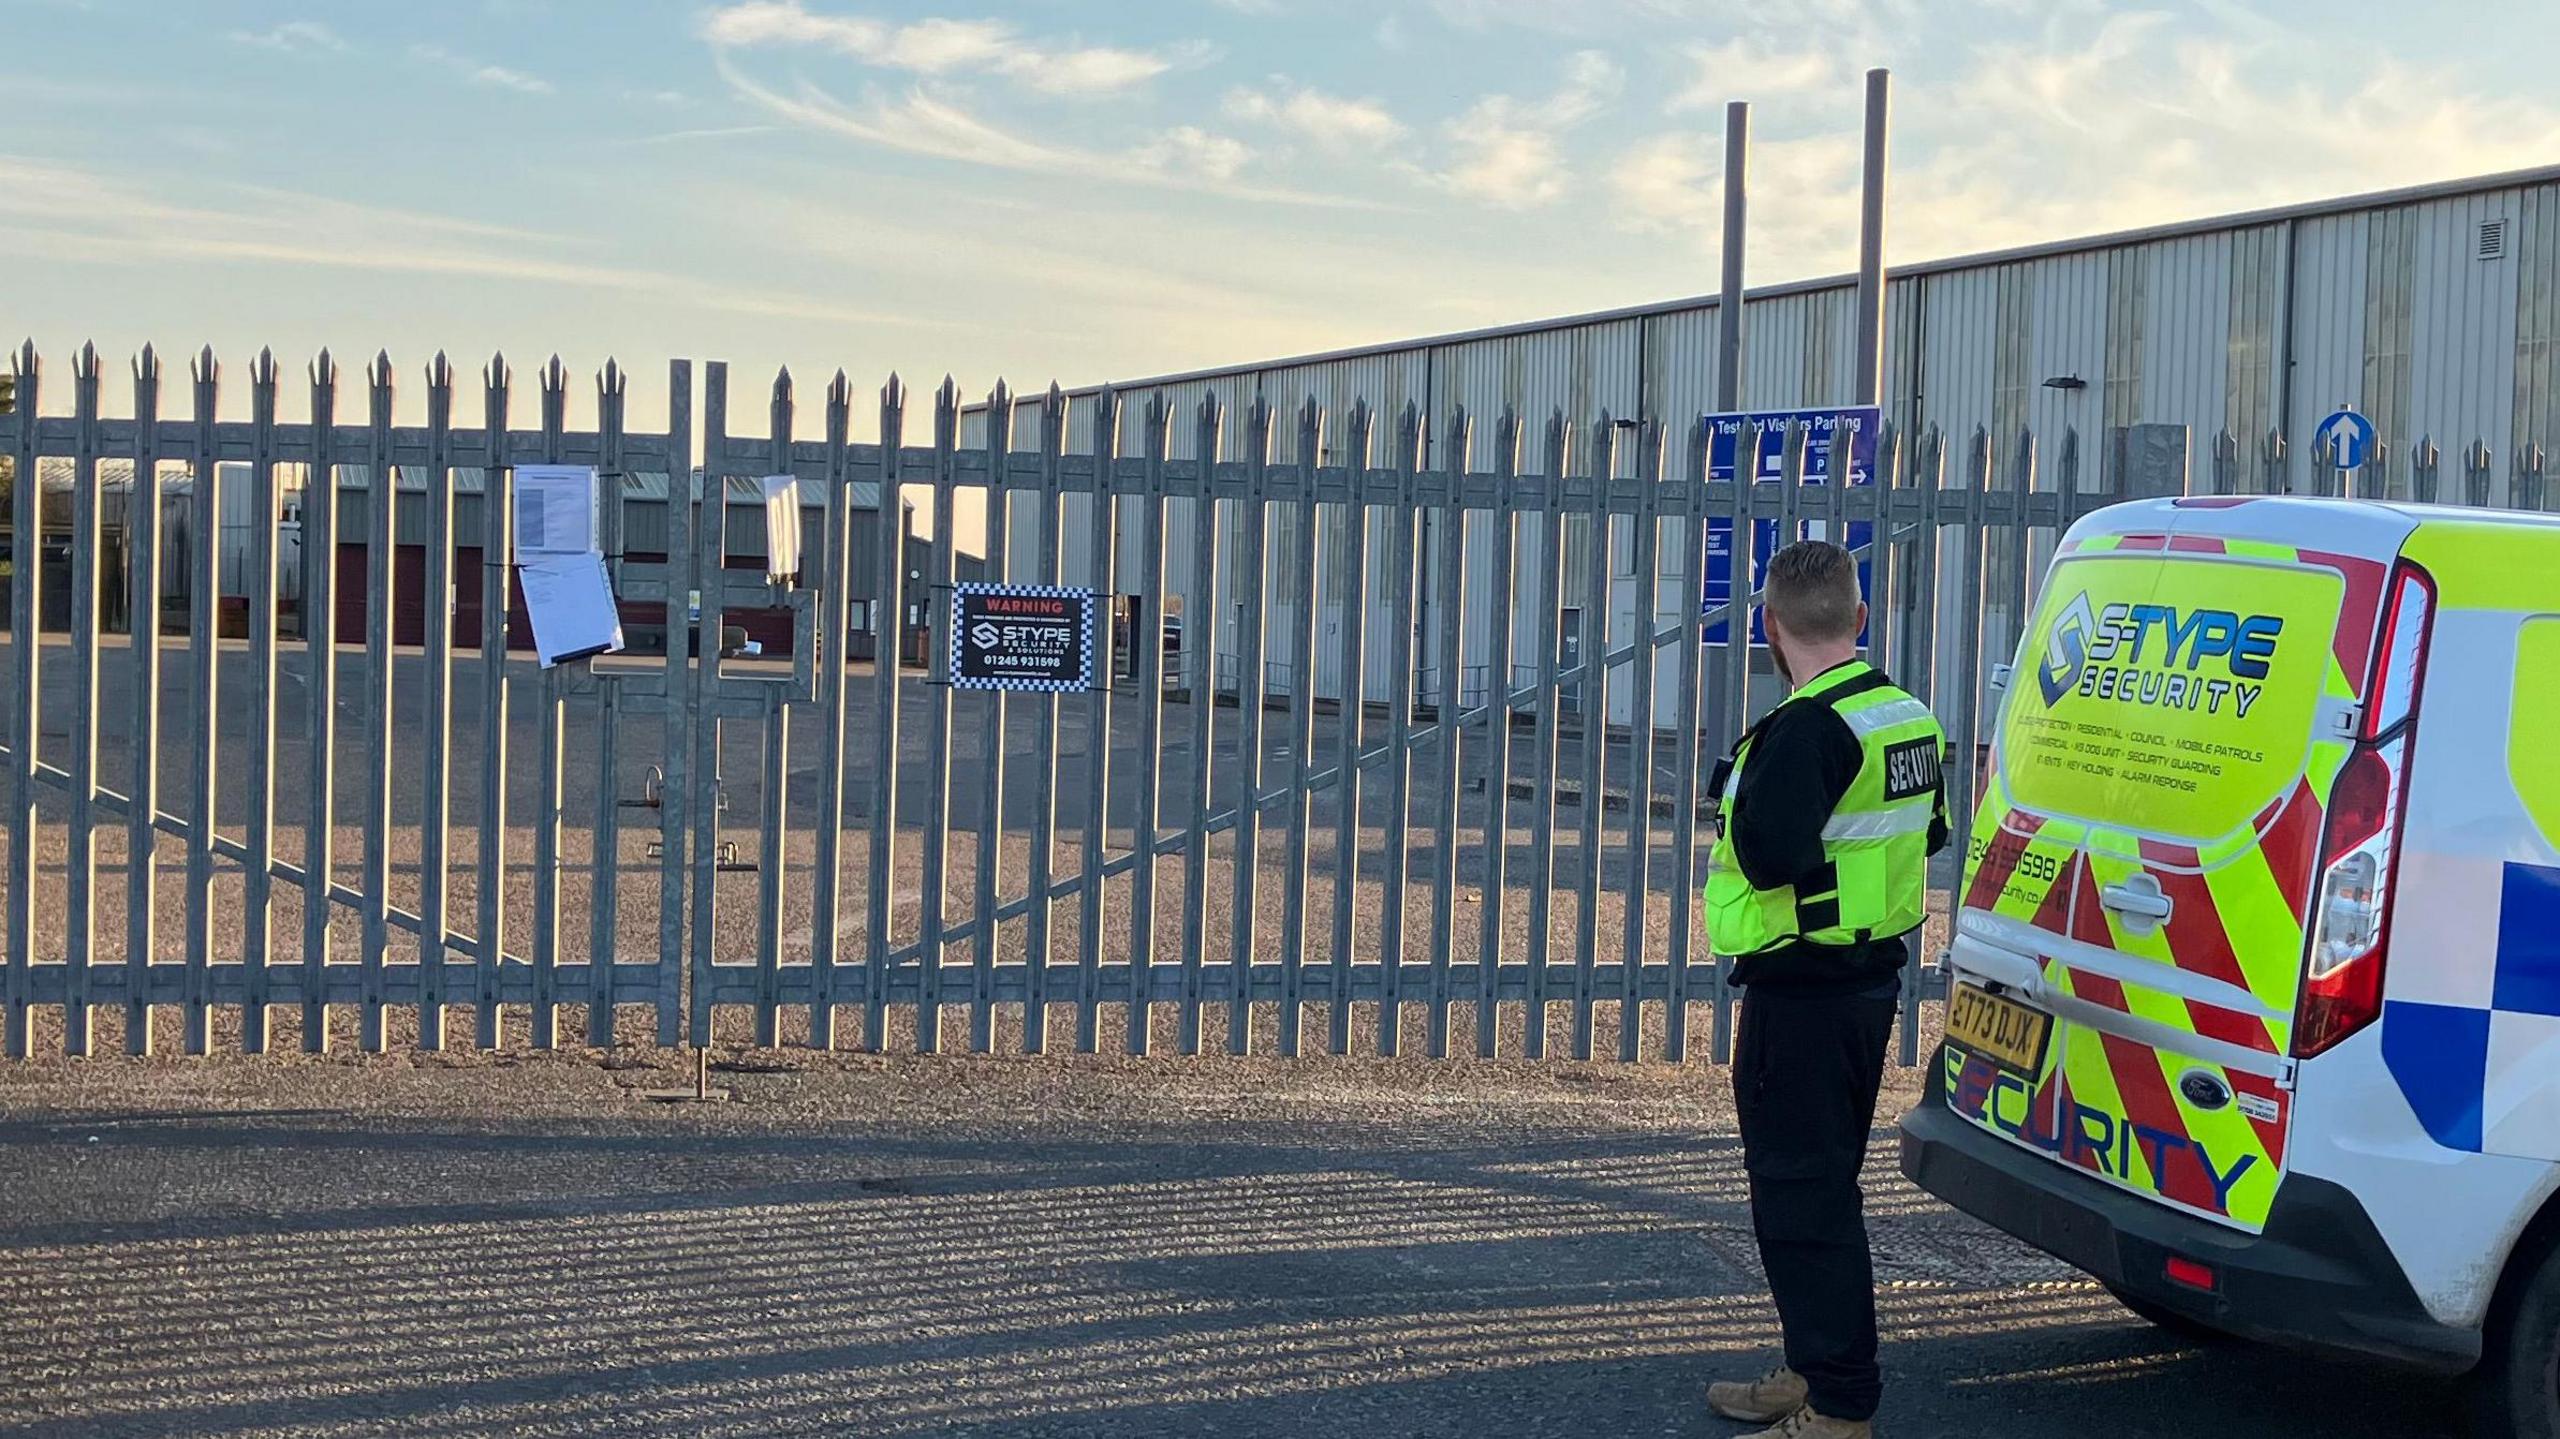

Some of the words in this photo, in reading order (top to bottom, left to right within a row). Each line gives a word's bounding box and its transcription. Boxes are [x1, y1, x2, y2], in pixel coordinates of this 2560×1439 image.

[986, 598, 1063, 614] WARNING
[1002, 625, 1071, 642] S-TYPE
[1002, 640, 1070, 649] SECURITY
[2088, 602, 2284, 680] S-TYPE
[984, 654, 1018, 666] 01245
[1020, 656, 1060, 667] 931598
[1017, 647, 1064, 655] SOLUTIONS
[2078, 665, 2262, 719] SECURITY
[2077, 723, 2123, 740] RESIDENTIAL
[2130, 731, 2166, 747] COUNCIL
[2175, 738, 2213, 754] MOBILE
[2213, 744, 2264, 763] PATROLS
[2102, 745, 2122, 759] UNIT
[2127, 750, 2170, 767] SECURITY
[2171, 758, 2221, 776] GUARDING
[2081, 762, 2115, 777] HOLDING
[2120, 769, 2152, 785] ALARM
[2153, 775, 2198, 793] REPONSE
[1995, 1004, 2034, 1055] DJX
[1946, 1050, 2258, 1209] SECURITY
